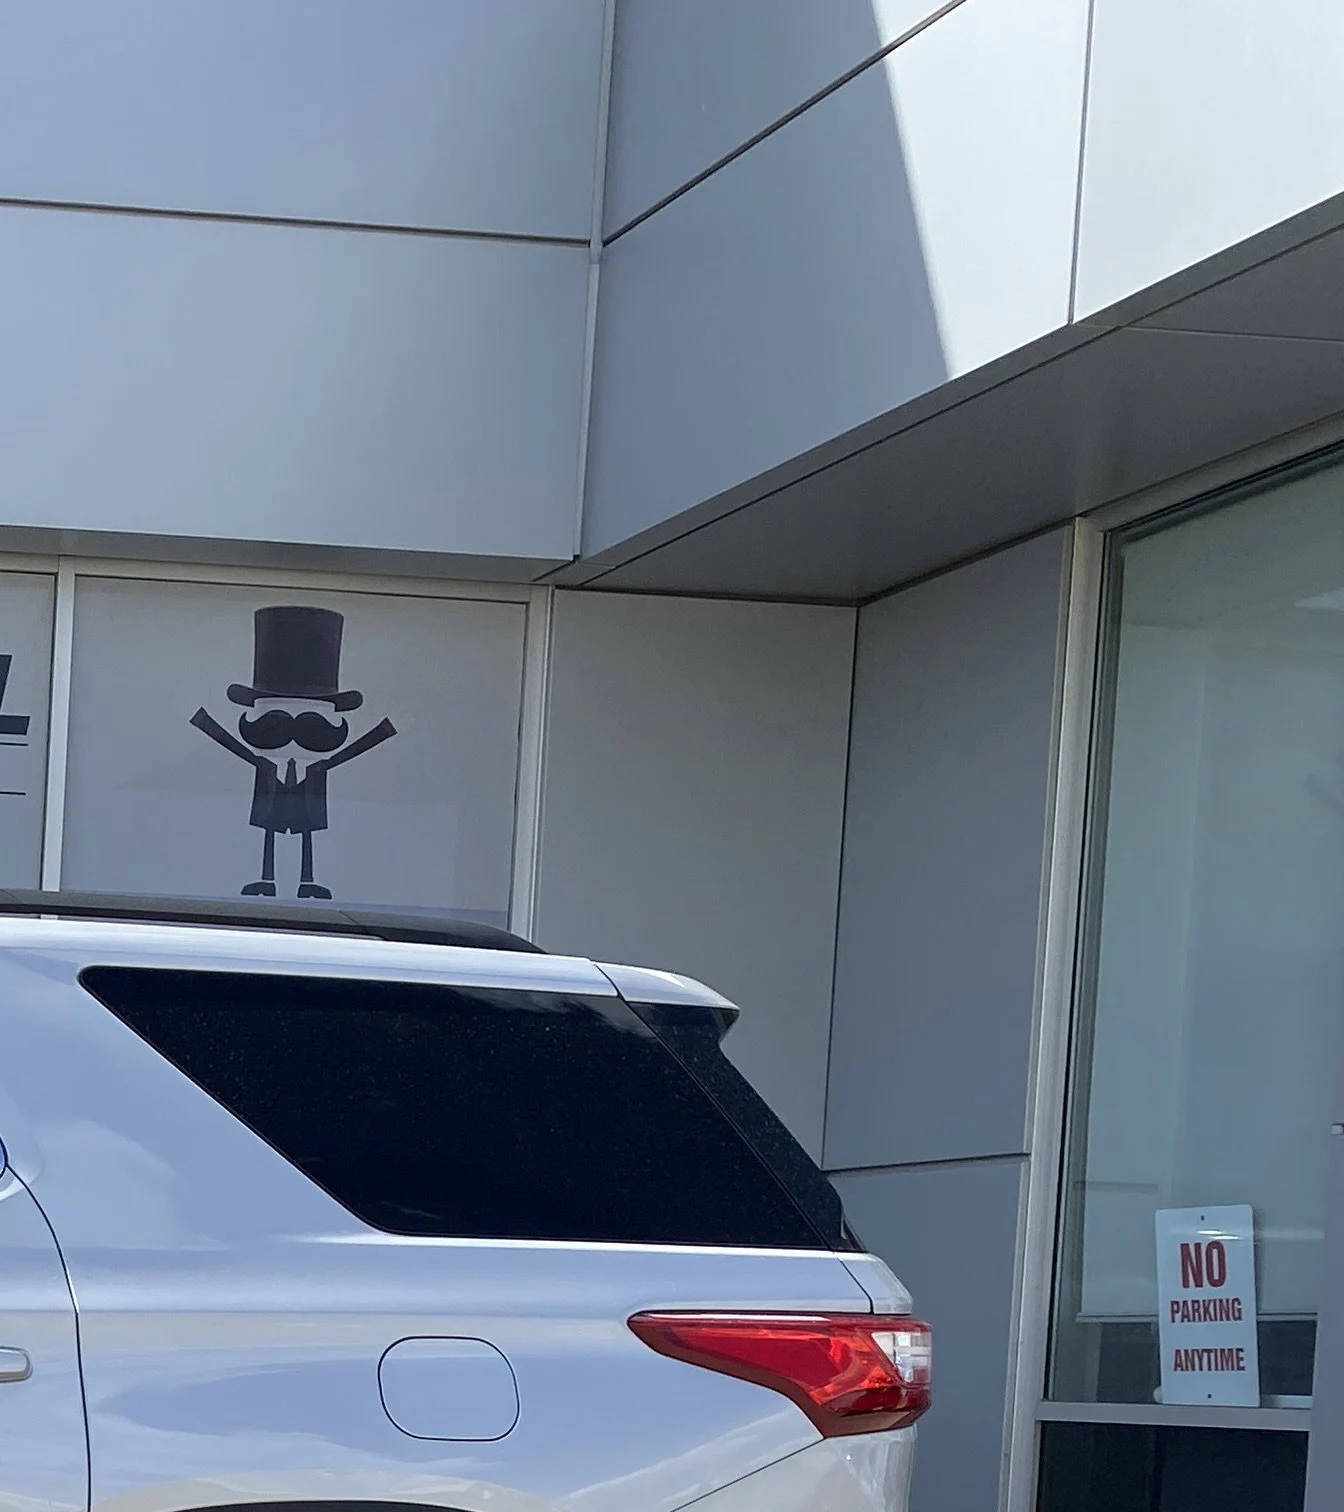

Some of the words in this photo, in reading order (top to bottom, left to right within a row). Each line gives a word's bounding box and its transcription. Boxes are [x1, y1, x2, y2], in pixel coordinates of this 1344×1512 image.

[1179, 1240, 1227, 1289] NO
[1170, 1298, 1243, 1324] PARKING
[1173, 1347, 1246, 1372] ANYTIME
